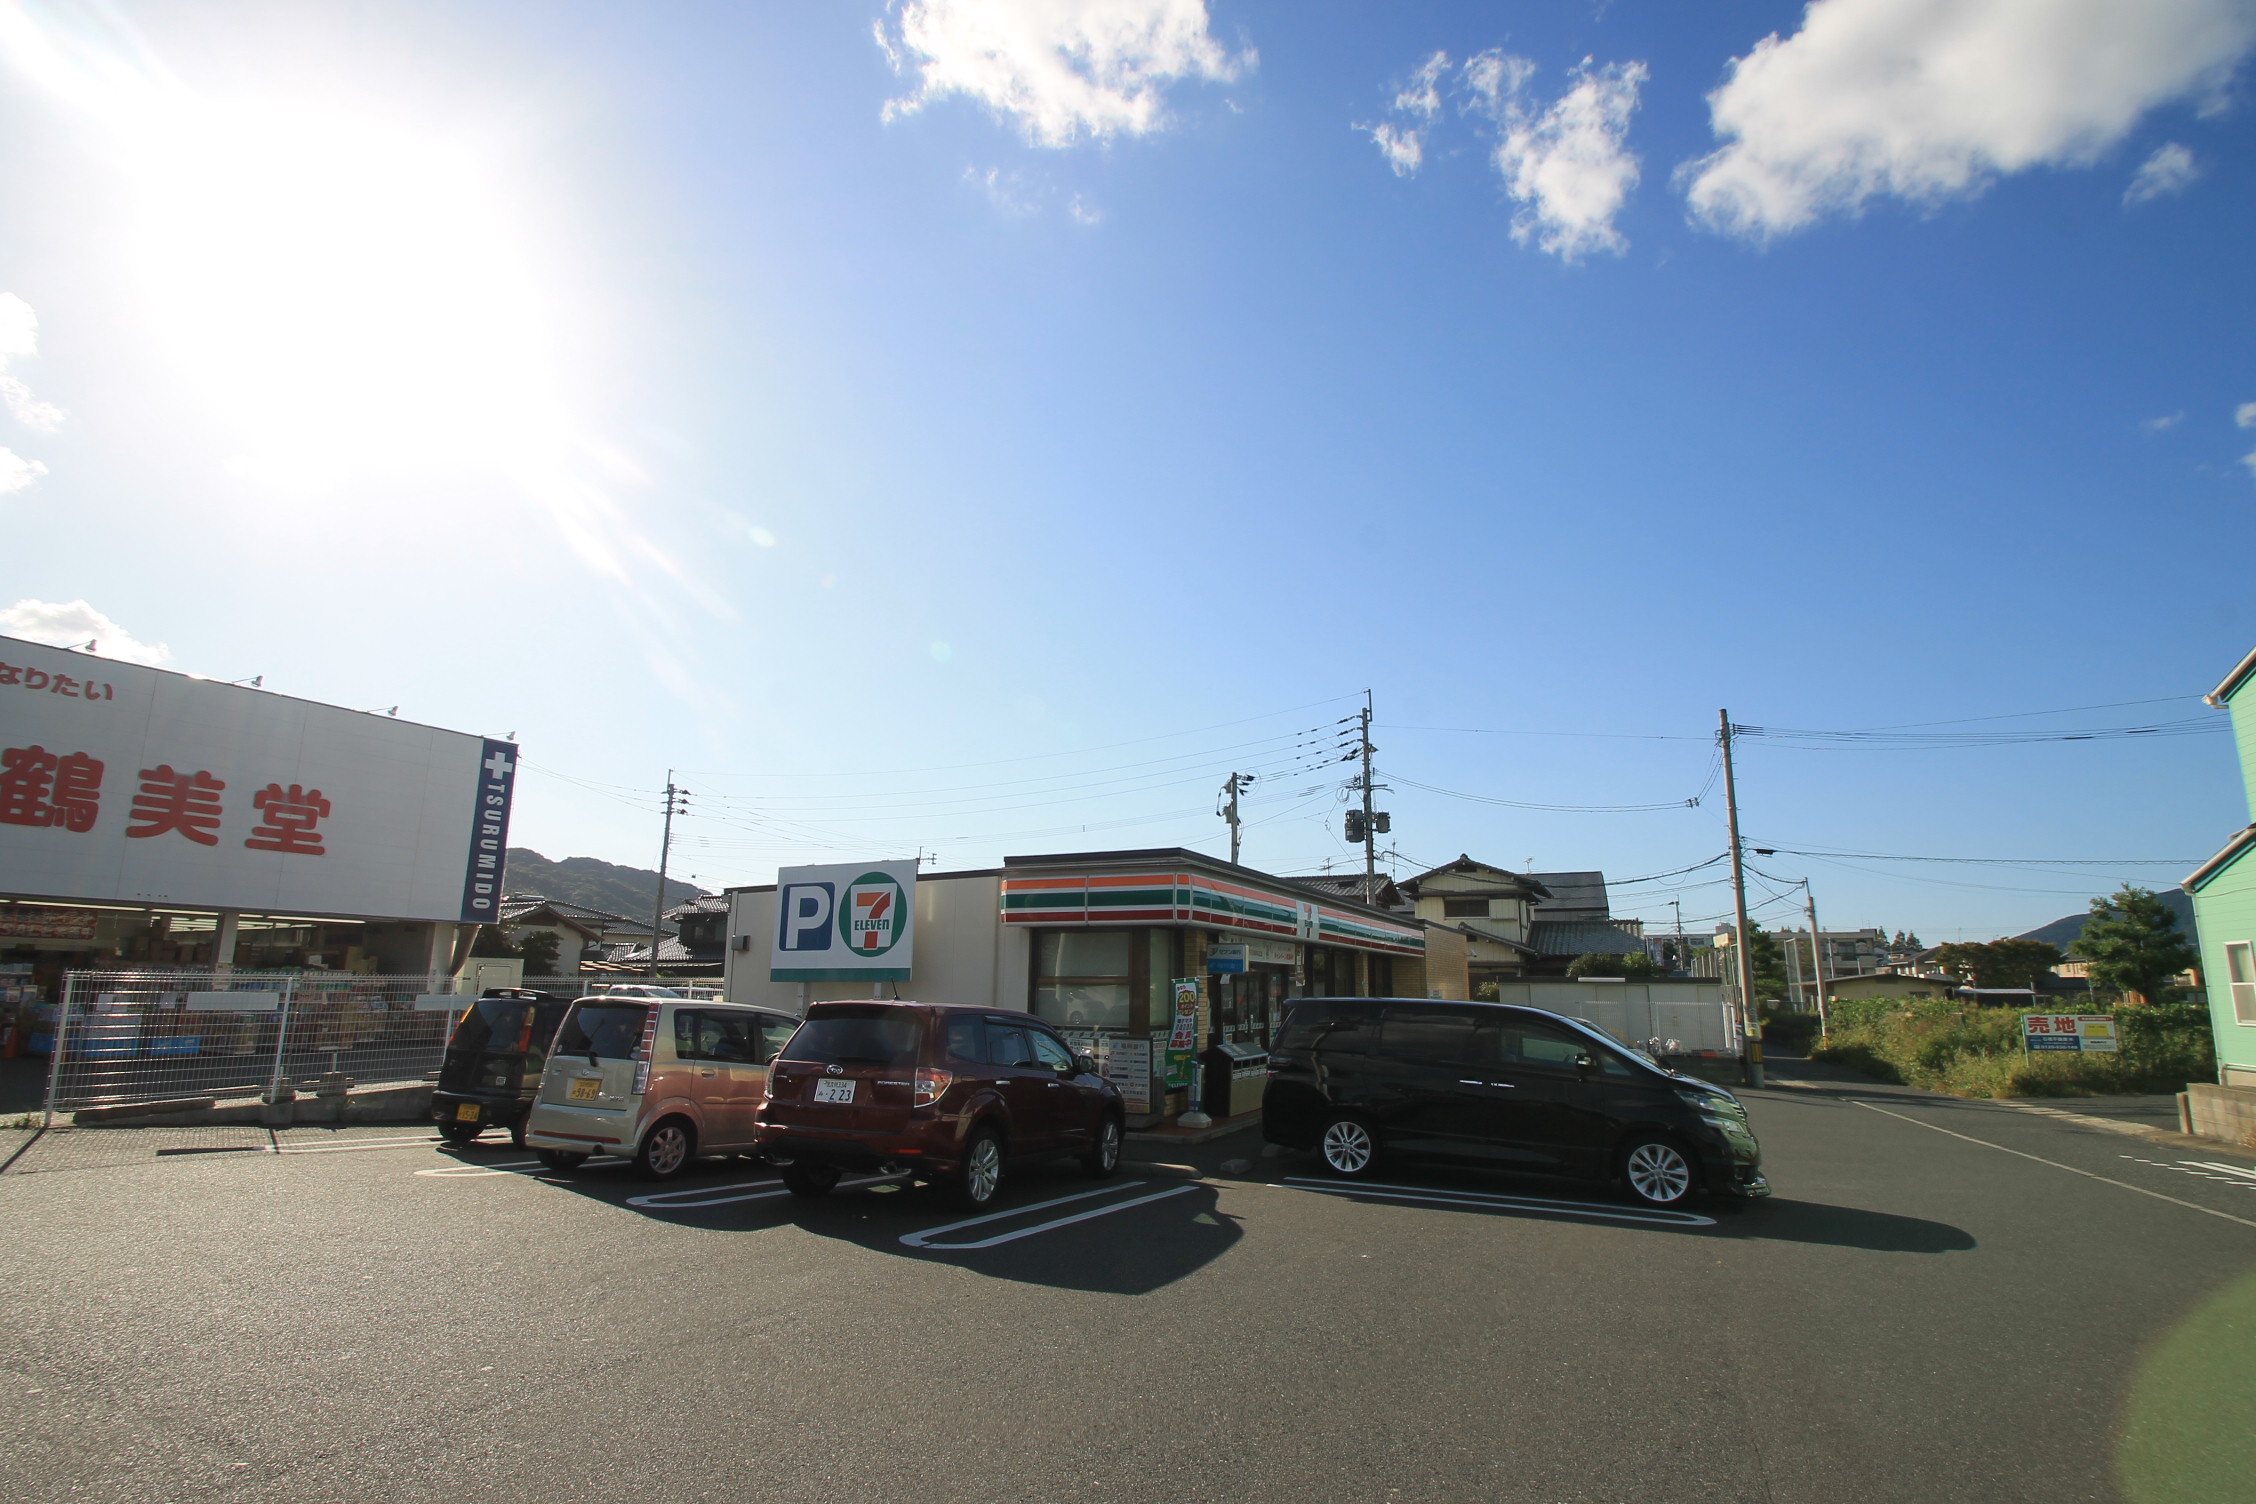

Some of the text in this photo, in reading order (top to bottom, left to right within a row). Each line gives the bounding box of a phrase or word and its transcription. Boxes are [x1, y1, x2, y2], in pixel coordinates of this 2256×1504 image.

[0, 744, 331, 856] 鶴美堂
[472, 783, 506, 910] TSURUMIDO
[786, 885, 831, 950] P
[856, 892, 891, 949] 7
[1178, 990, 1195, 1003] 200
[2027, 1016, 2077, 1034] 売地
